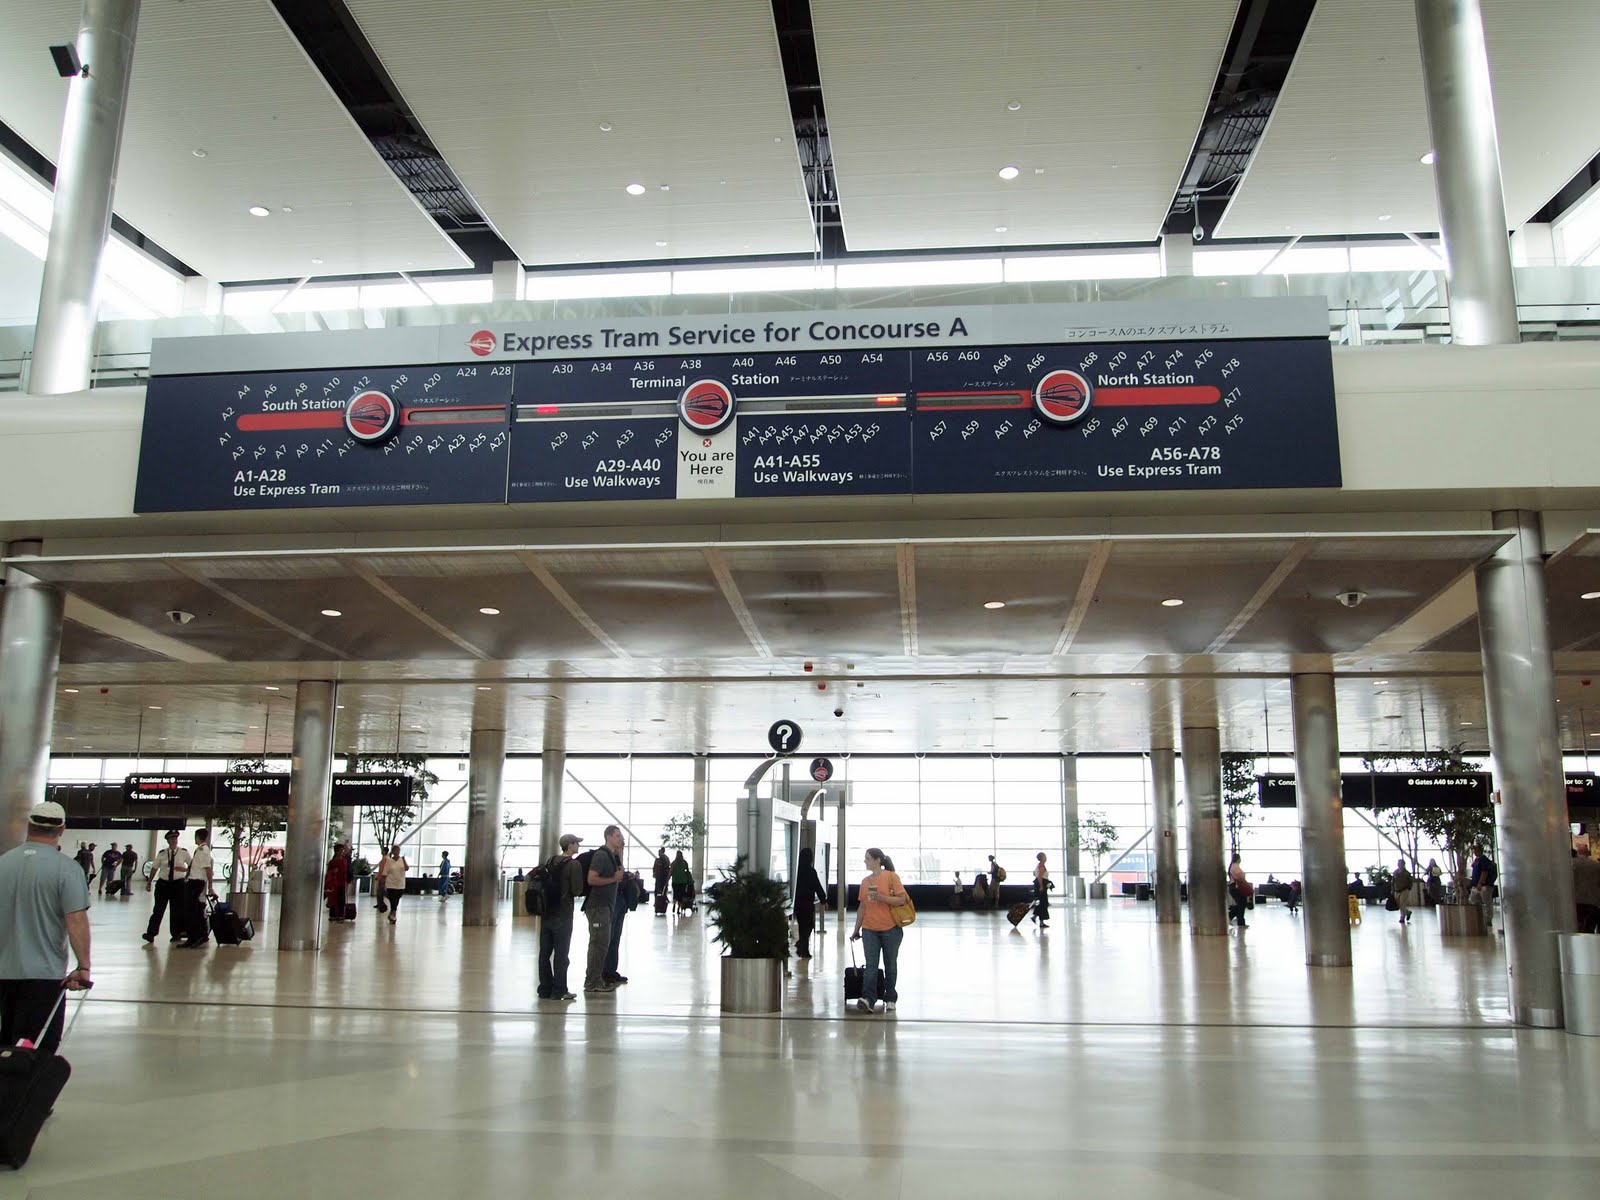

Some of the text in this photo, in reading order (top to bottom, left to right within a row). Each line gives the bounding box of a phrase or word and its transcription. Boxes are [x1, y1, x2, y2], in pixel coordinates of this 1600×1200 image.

[504, 317, 968, 354] Express Tram Service for Concourse A
[681, 360, 701, 369] A38
[733, 358, 753, 367] A40
[775, 356, 796, 365] A46
[820, 355, 841, 364] A50
[862, 354, 883, 363] A54
[927, 352, 948, 361] A56
[958, 351, 980, 360] A60
[993, 354, 1011, 374] A64
[1027, 353, 1045, 373] A66
[1080, 352, 1098, 371] A68
[1109, 352, 1126, 371] A70
[1137, 351, 1155, 370] A72
[1165, 350, 1183, 369] A74
[1195, 349, 1213, 368] A76
[457, 368, 476, 376] A24
[491, 366, 511, 375] A28
[552, 364, 573, 373] A30
[591, 363, 612, 372] A34
[634, 361, 654, 370] A36
[1222, 359, 1240, 378] A78
[323, 378, 340, 396] A10
[353, 375, 371, 393] A12
[391, 375, 408, 393] A18
[424, 373, 441, 392] A20
[630, 373, 779, 388] Terminal Station
[1099, 373, 1193, 385] North Station
[238, 385, 250, 399] A4
[265, 384, 277, 398] A6
[295, 383, 307, 397] A8
[1224, 387, 1241, 407] A77
[262, 398, 345, 411] South Station
[223, 407, 234, 421] A2
[862, 423, 879, 442] A55
[930, 421, 946, 440] A57
[962, 421, 979, 440] A59
[995, 420, 1012, 439] A61
[1023, 419, 1041, 438] A63
[1082, 418, 1100, 437] A65
[1112, 417, 1128, 437] A67
[1140, 417, 1157, 436] A69
[1169, 417, 1186, 436] A71
[1199, 416, 1216, 435] A73
[1225, 414, 1243, 434] A75
[220, 432, 231, 445] A1
[469, 433, 486, 452] A25
[490, 432, 505, 451] A27
[551, 432, 568, 450] A29
[582, 431, 599, 449] A31
[617, 430, 634, 448] A33
[655, 428, 672, 447] A35
[743, 427, 759, 445] A41
[759, 426, 776, 445] A43
[776, 425, 793, 444] A45
[793, 425, 809, 444] A47
[810, 425, 827, 444] A49
[828, 425, 844, 443] A51
[845, 424, 862, 443] A53
[254, 445, 266, 459] A5
[276, 445, 286, 459] A7
[297, 444, 308, 458] A9
[317, 439, 332, 457] A11
[338, 439, 354, 456] A15
[384, 436, 399, 455] A17
[406, 436, 423, 454] A19
[427, 436, 444, 453] A21
[448, 434, 465, 453] A23
[233, 446, 244, 460] A3
[681, 451, 734, 461] You are
[754, 455, 820, 468] A41-A55
[1151, 447, 1220, 460] A56-A78
[596, 459, 660, 472] A29-A40
[691, 464, 723, 474] Here
[1098, 464, 1221, 478] Use Express Tram
[235, 469, 286, 482] A1-A28
[565, 475, 660, 488] Use Walkways
[755, 470, 853, 484] Use Walkways
[234, 484, 340, 497] Use Express Tram
